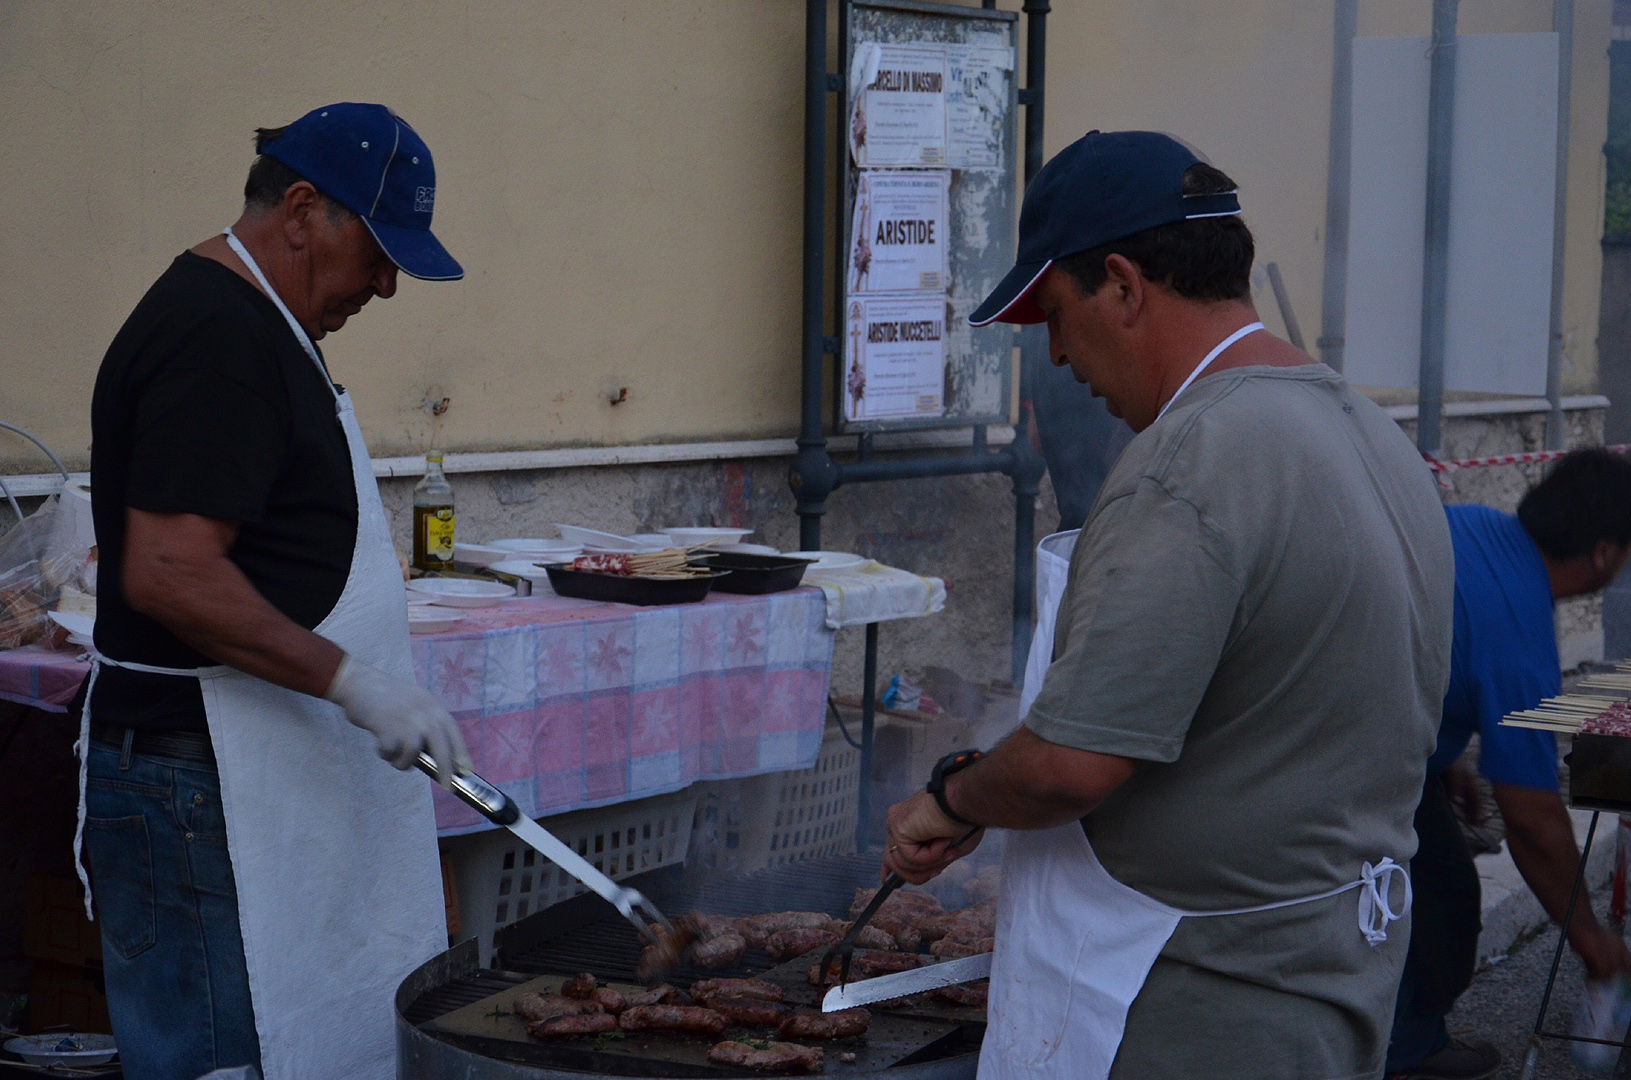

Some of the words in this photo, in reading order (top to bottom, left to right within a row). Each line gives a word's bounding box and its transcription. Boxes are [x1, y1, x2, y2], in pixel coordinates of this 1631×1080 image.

[912, 71, 942, 92] MASSIMO
[876, 219, 936, 245] ARISTIDE
[867, 322, 898, 343] ARISTIDE
[900, 320, 941, 341] NUCCETELLI
